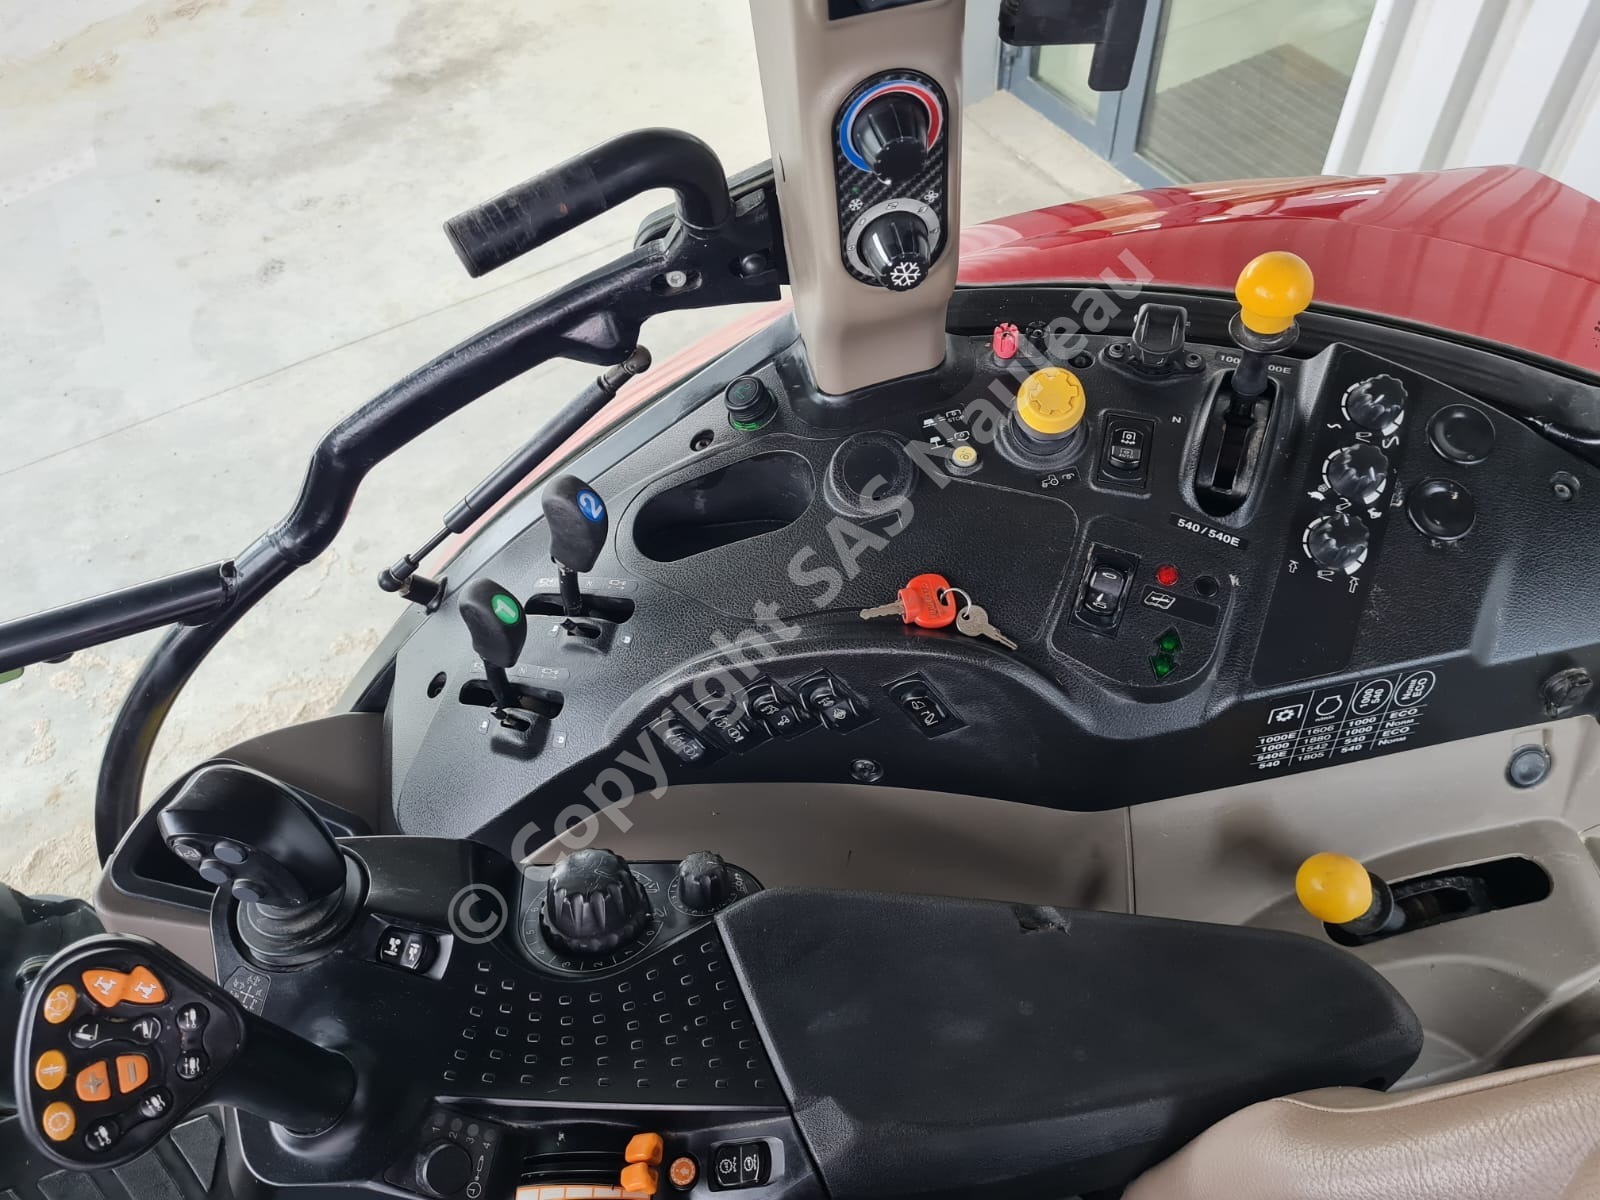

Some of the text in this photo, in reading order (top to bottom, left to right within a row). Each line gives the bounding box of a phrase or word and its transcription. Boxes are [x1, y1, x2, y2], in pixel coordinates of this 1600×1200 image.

[1171, 415, 1182, 424] N
[579, 492, 602, 519] 2
[494, 598, 516, 618] 1
[1260, 708, 1418, 744] 1000E 1606 1000 ECO
[1262, 742, 1290, 752] 1000
[1304, 734, 1332, 744] 1880
[1345, 726, 1373, 736] 1000
[1257, 751, 1288, 761] 540E
[1344, 735, 1366, 745] 540
[1382, 726, 1410, 737] ECO
[1258, 760, 1280, 769] 540
[1298, 752, 1325, 761] 1805
[1341, 744, 1363, 753] 540
